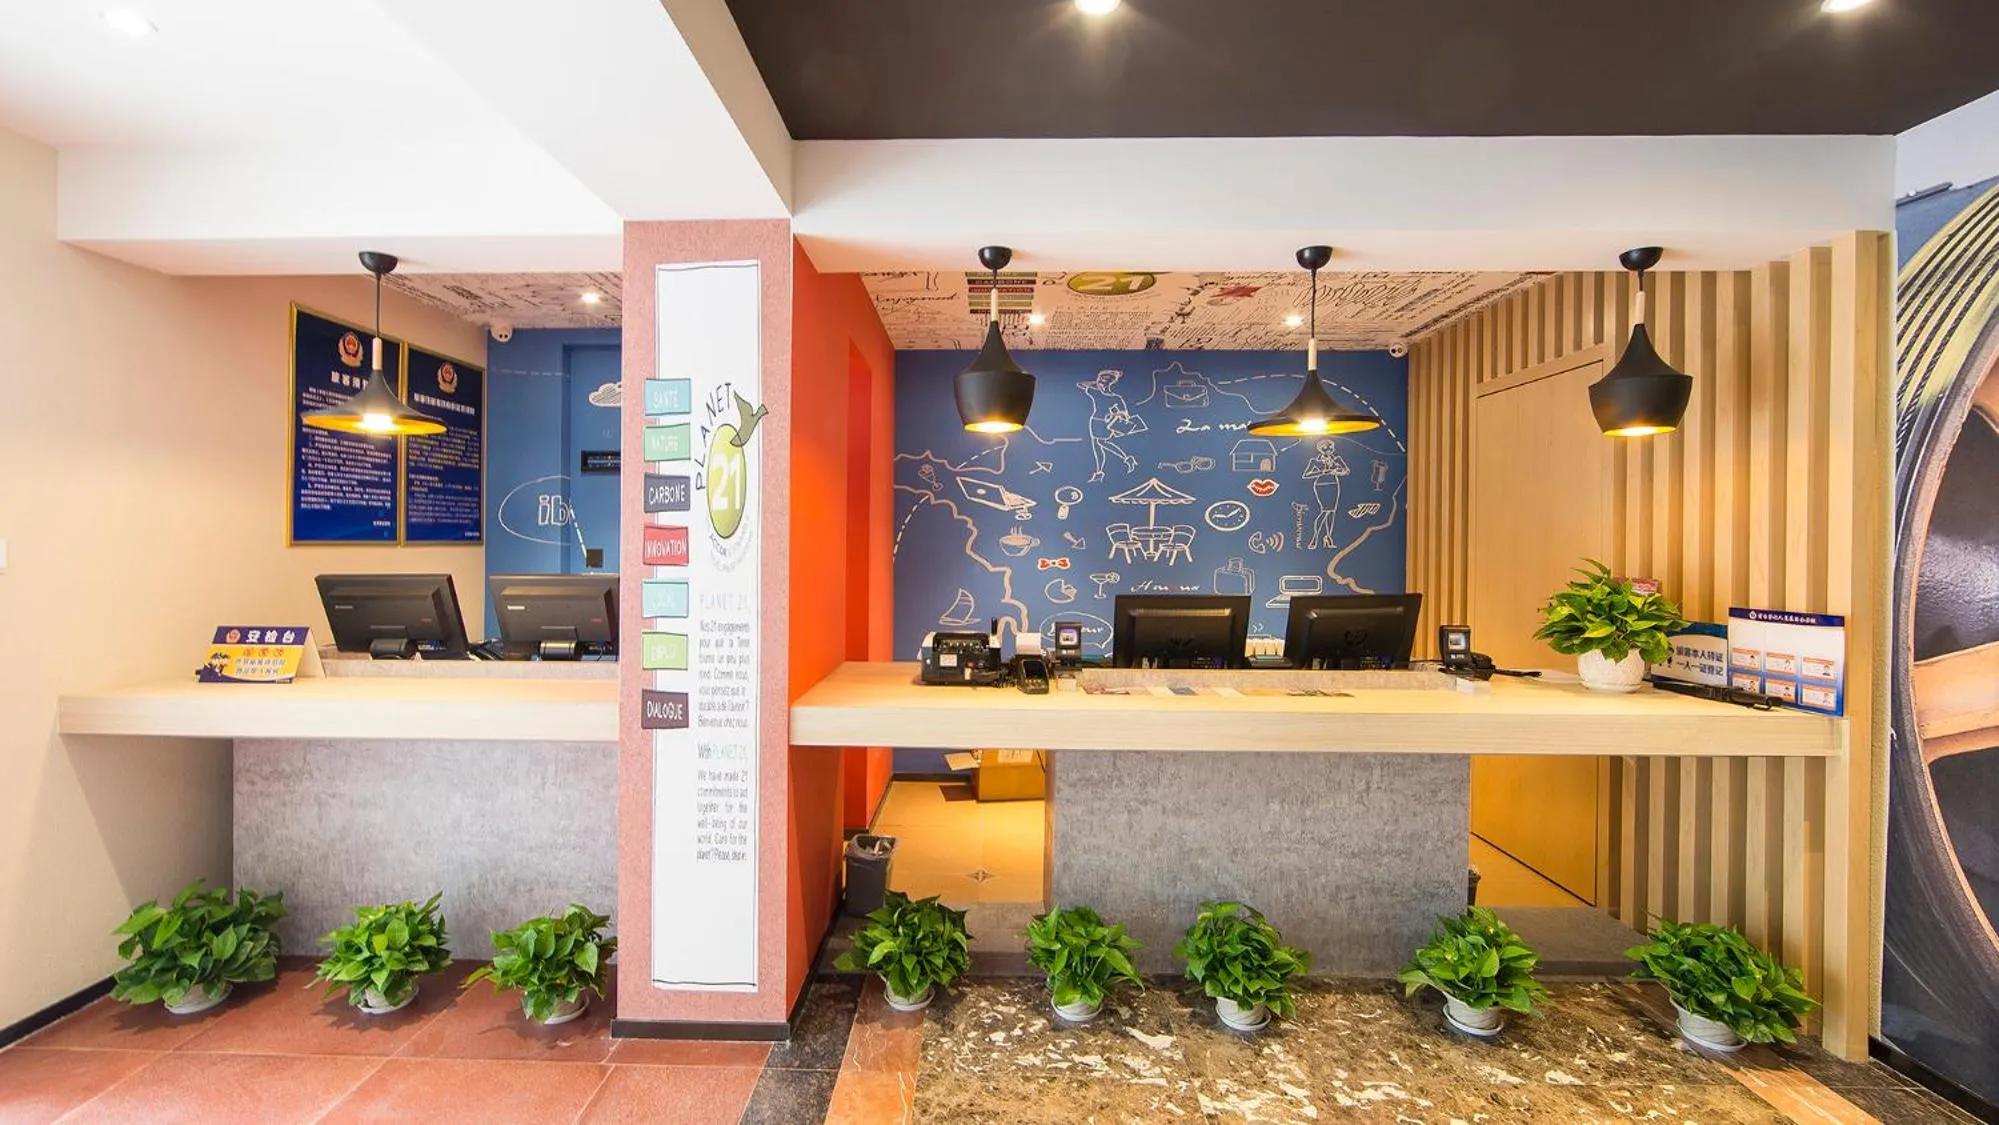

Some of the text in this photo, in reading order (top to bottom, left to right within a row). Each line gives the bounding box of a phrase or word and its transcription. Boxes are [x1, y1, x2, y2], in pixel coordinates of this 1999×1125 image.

[695, 382, 732, 490] PLANET
[711, 452, 741, 510] 21
[648, 484, 686, 505] CARBONE
[645, 539, 687, 559] INNOVATION
[246, 629, 295, 644] 安检台
[647, 701, 683, 721] DIALOGUE
